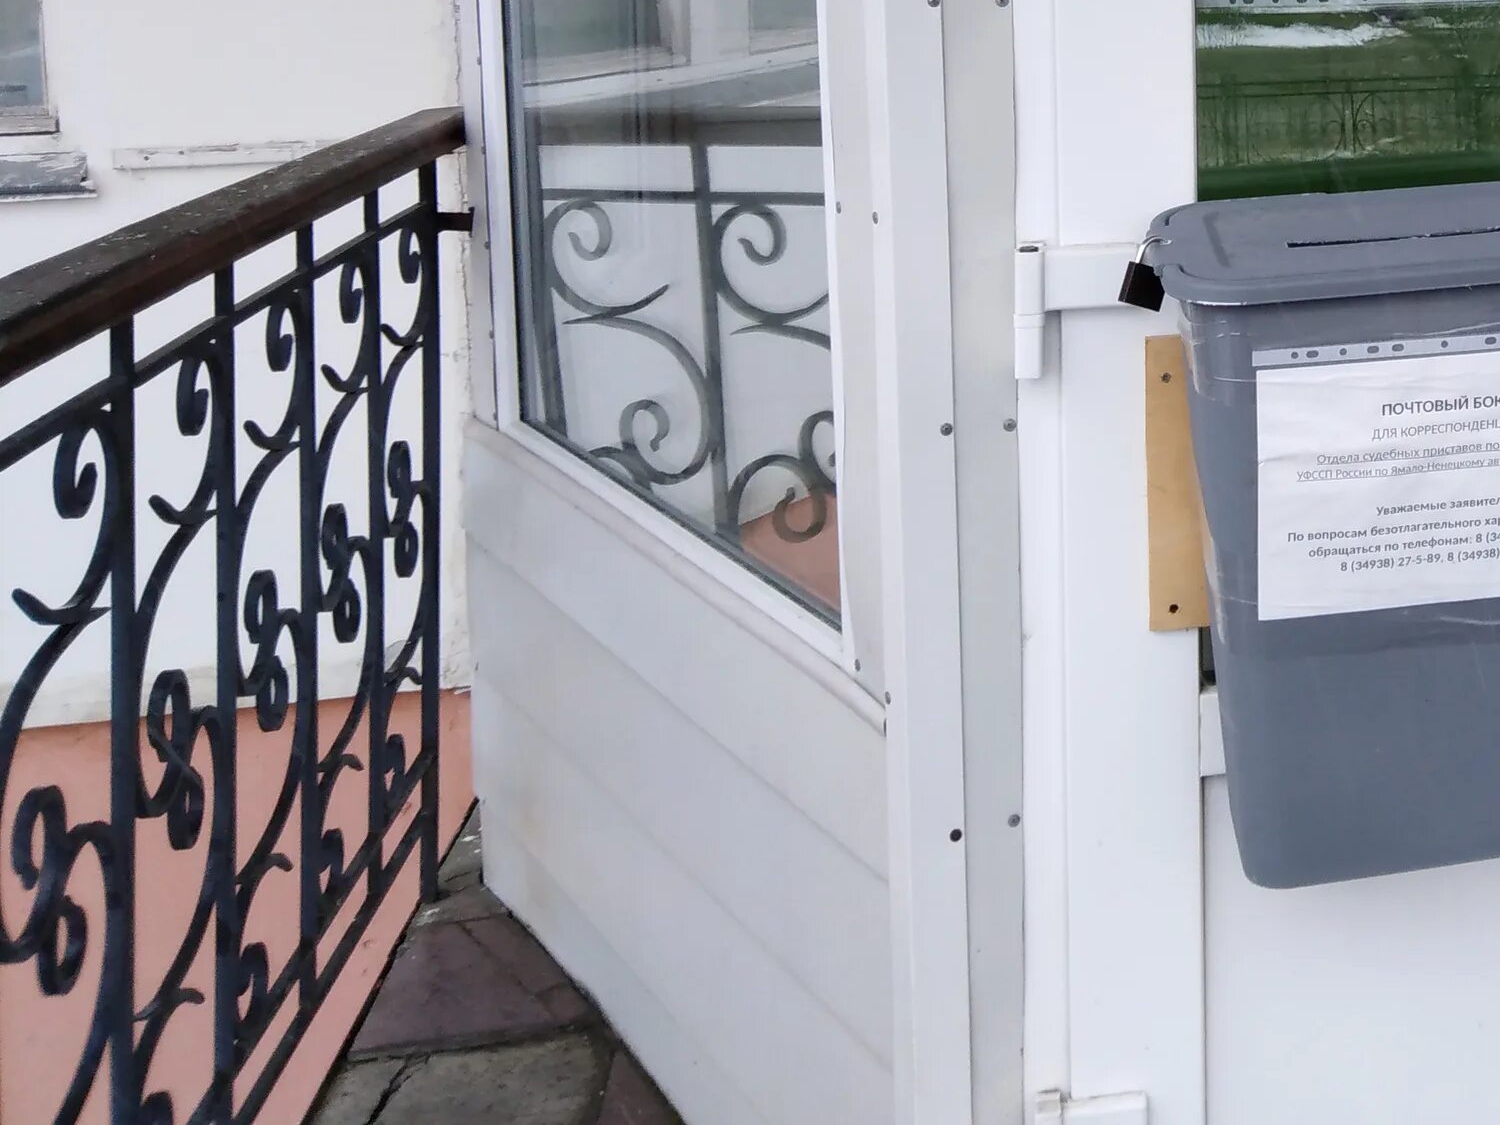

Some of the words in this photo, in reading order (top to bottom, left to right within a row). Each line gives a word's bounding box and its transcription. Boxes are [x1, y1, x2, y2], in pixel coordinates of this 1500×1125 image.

[1382, 395, 1469, 416] ПОЧТОВЫЙ
[1372, 427, 1398, 441] ДЛЯ
[1317, 451, 1360, 465] Отдела
[1362, 446, 1420, 463] судебных
[1422, 442, 1484, 459] приставов
[1485, 441, 1500, 452] по
[1296, 468, 1333, 482] УФССП
[1336, 466, 1373, 479] России
[1375, 466, 1388, 478] по
[1391, 458, 1485, 476] Ямало-Ненецкому
[1376, 500, 1447, 516] Уважаемые
[1288, 530, 1304, 542] По
[1307, 527, 1367, 543] вопросам
[1371, 516, 1481, 537] безотлагательного
[1308, 541, 1381, 558] обращаться
[1384, 541, 1400, 554] по
[1403, 534, 1472, 553] телефонам:
[1475, 532, 1483, 543] 8
[1340, 560, 1348, 572] 8
[1351, 556, 1394, 573] (34938)
[1398, 552, 1443, 567] 27-5-89,
[1447, 550, 1454, 562] 8
[1458, 546, 1500, 563] (34938)
